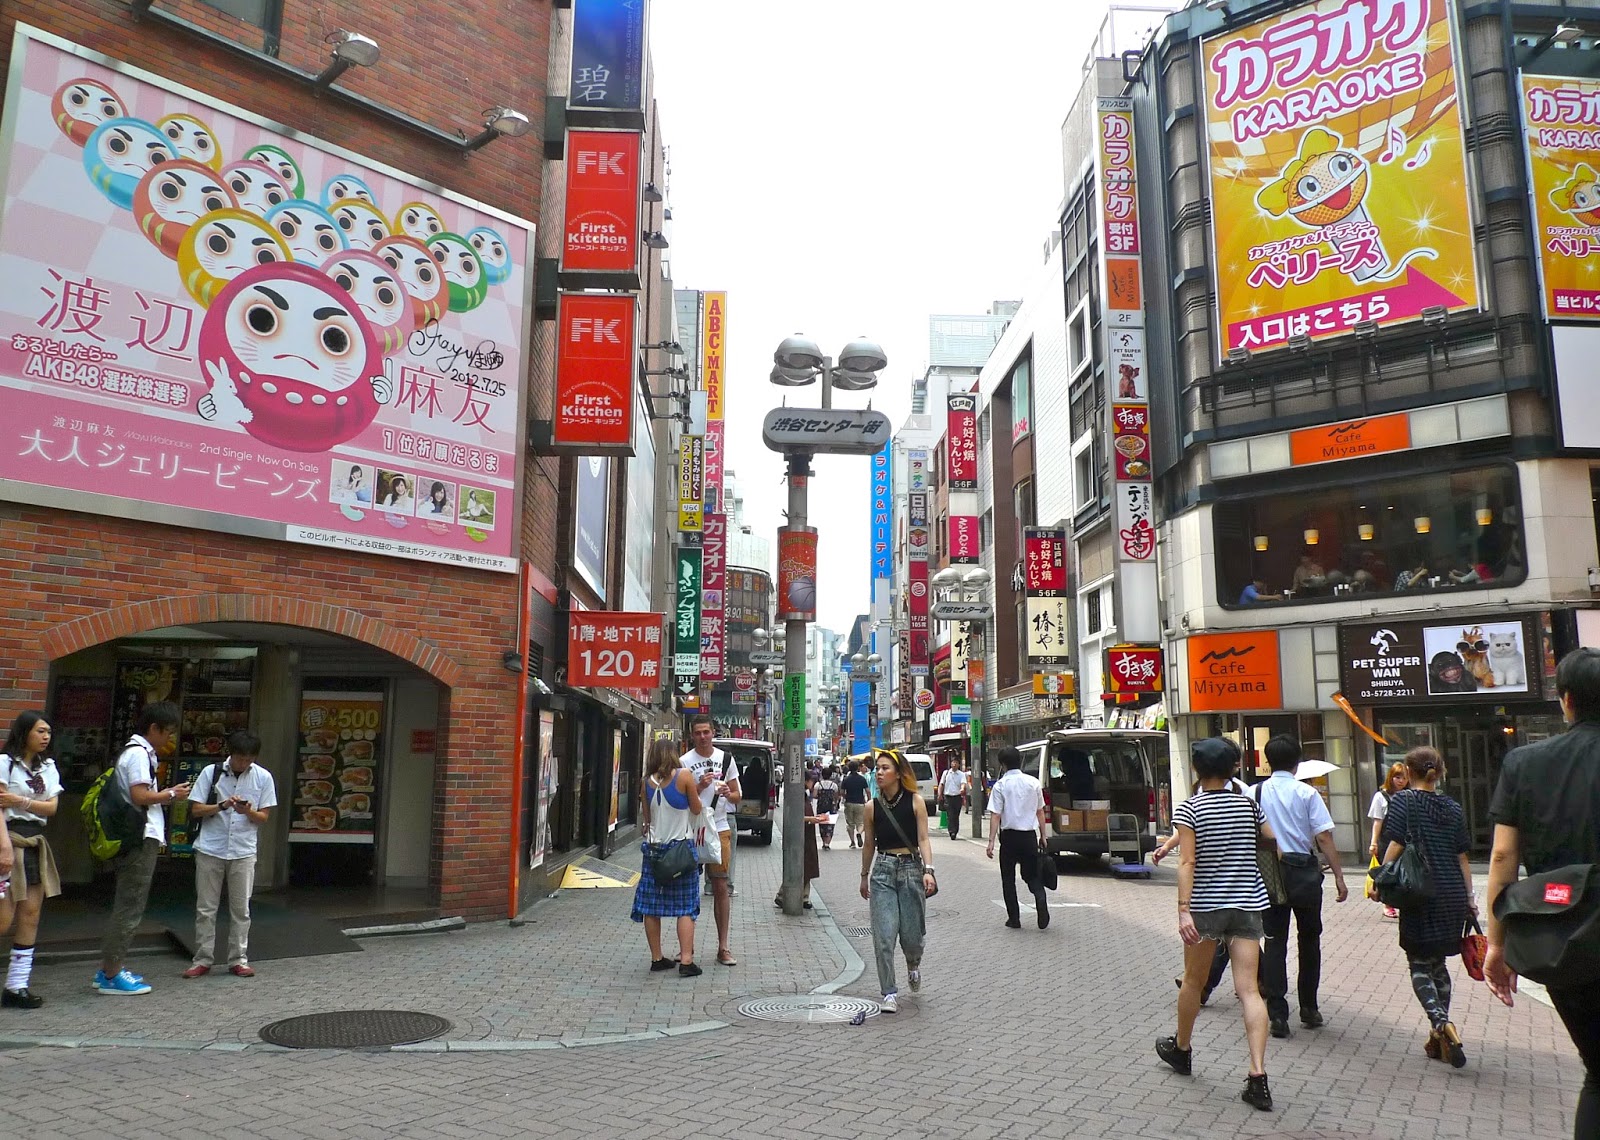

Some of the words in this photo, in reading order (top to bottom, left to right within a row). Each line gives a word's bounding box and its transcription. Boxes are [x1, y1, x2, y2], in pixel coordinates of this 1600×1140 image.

[1212, 0, 1430, 108] カラオケ
[575, 64, 610, 101] 碧
[1234, 53, 1424, 141] KARAOKE
[577, 151, 625, 175] FK
[1103, 114, 1133, 219] カラオケ
[568, 233, 628, 245] Kitchen
[580, 222, 615, 233] First
[1109, 222, 1133, 235] 受付
[1109, 236, 1134, 251] 3F
[1248, 228, 1382, 288] ベリーズ
[571, 317, 621, 343] FK
[1118, 314, 1132, 322] 2F
[1238, 295, 1391, 348] 入口はこちら
[36, 267, 193, 361] 渡辺
[394, 366, 498, 434] 麻友
[26, 354, 101, 387] AKB48
[101, 368, 190, 406] 選抜総選挙
[450, 368, 507, 397] 2012.7.25
[562, 405, 623, 418] Kitchen
[575, 394, 611, 406] First
[770, 418, 884, 435] 渋谷センター街
[1117, 407, 1145, 427] すき家
[52, 415, 116, 439] 渡辺麻友
[200, 442, 220, 455] 2nd
[222, 447, 253, 462] Single
[257, 454, 280, 467] Now
[282, 458, 297, 470] On
[299, 461, 319, 474] Sale
[962, 416, 976, 461] お好み焼
[1322, 443, 1377, 458] Miyama
[1336, 433, 1361, 444] Cafe
[383, 430, 499, 473] 1位祈願だるま
[951, 435, 963, 477] もんじゃ
[19, 428, 322, 503] 大人ジェリービーンズ
[875, 445, 887, 579] ラオケ&パーティー
[958, 556, 969, 564] 4F
[1028, 551, 1040, 588] もんじゃ
[1041, 540, 1052, 582] お好み焼
[570, 624, 661, 643] 1階・地下1階
[580, 649, 658, 677] 120席
[1115, 652, 1156, 681] すき家
[1209, 662, 1246, 675] Cafe
[1352, 659, 1376, 669] PET
[1379, 656, 1421, 668] SUPER
[1372, 668, 1401, 678] WAN
[1194, 679, 1268, 697] Miyama
[1361, 689, 1416, 698] 03-5728-2211
[1371, 679, 1404, 687] SHIBUYA
